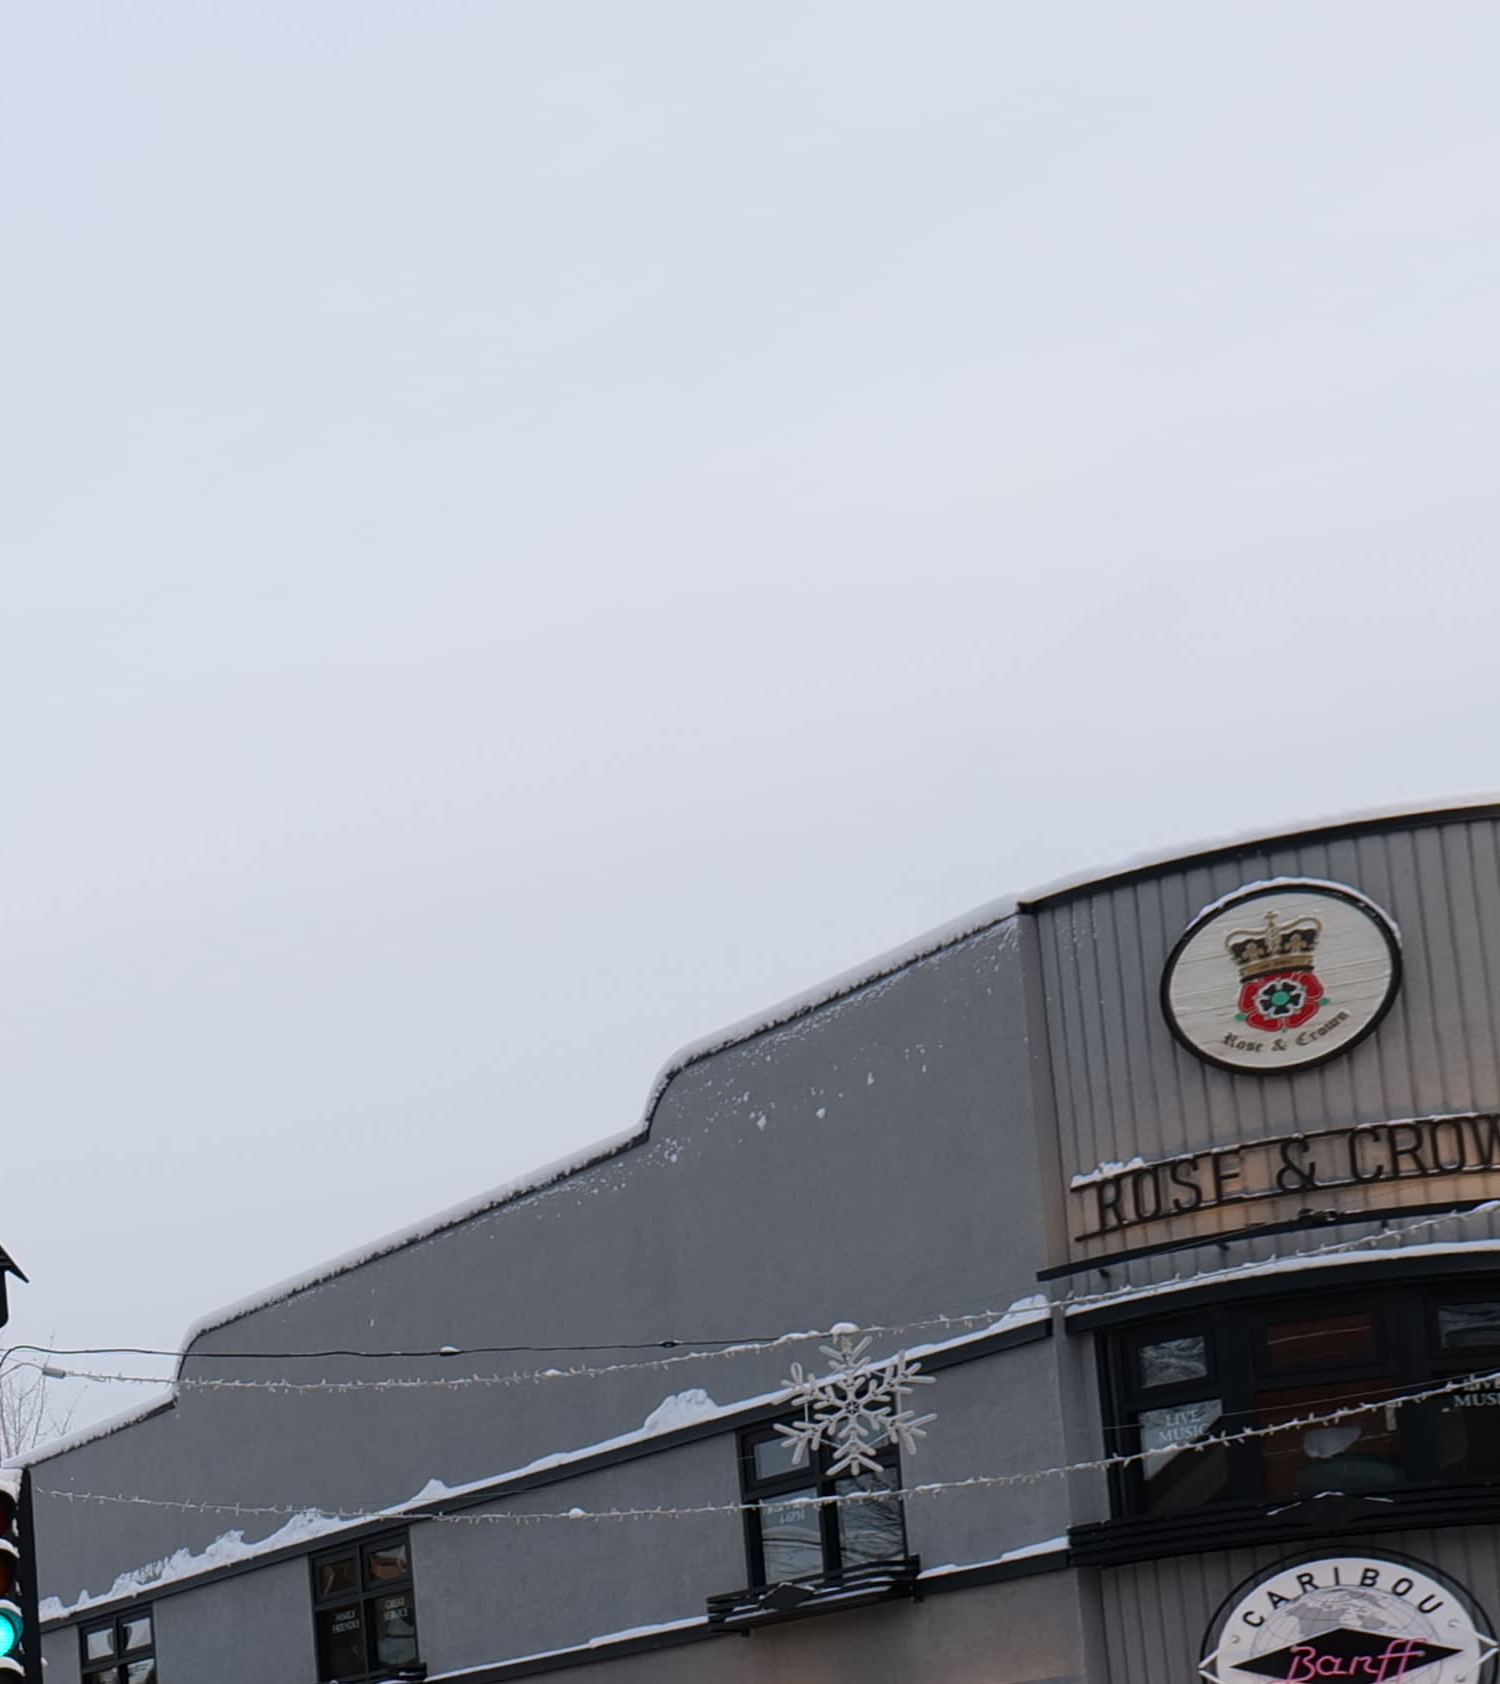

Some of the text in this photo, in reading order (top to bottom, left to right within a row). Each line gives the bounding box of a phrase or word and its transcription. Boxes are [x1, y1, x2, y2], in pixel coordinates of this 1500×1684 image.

[1222, 1010, 1348, 1051] Rose & Crown
[1096, 1113, 1500, 1229] ROSE & CROW
[1158, 1424, 1206, 1443] MUSIC
[1165, 1409, 1201, 1426] LIVE
[1242, 1566, 1444, 1628] CARIBOU
